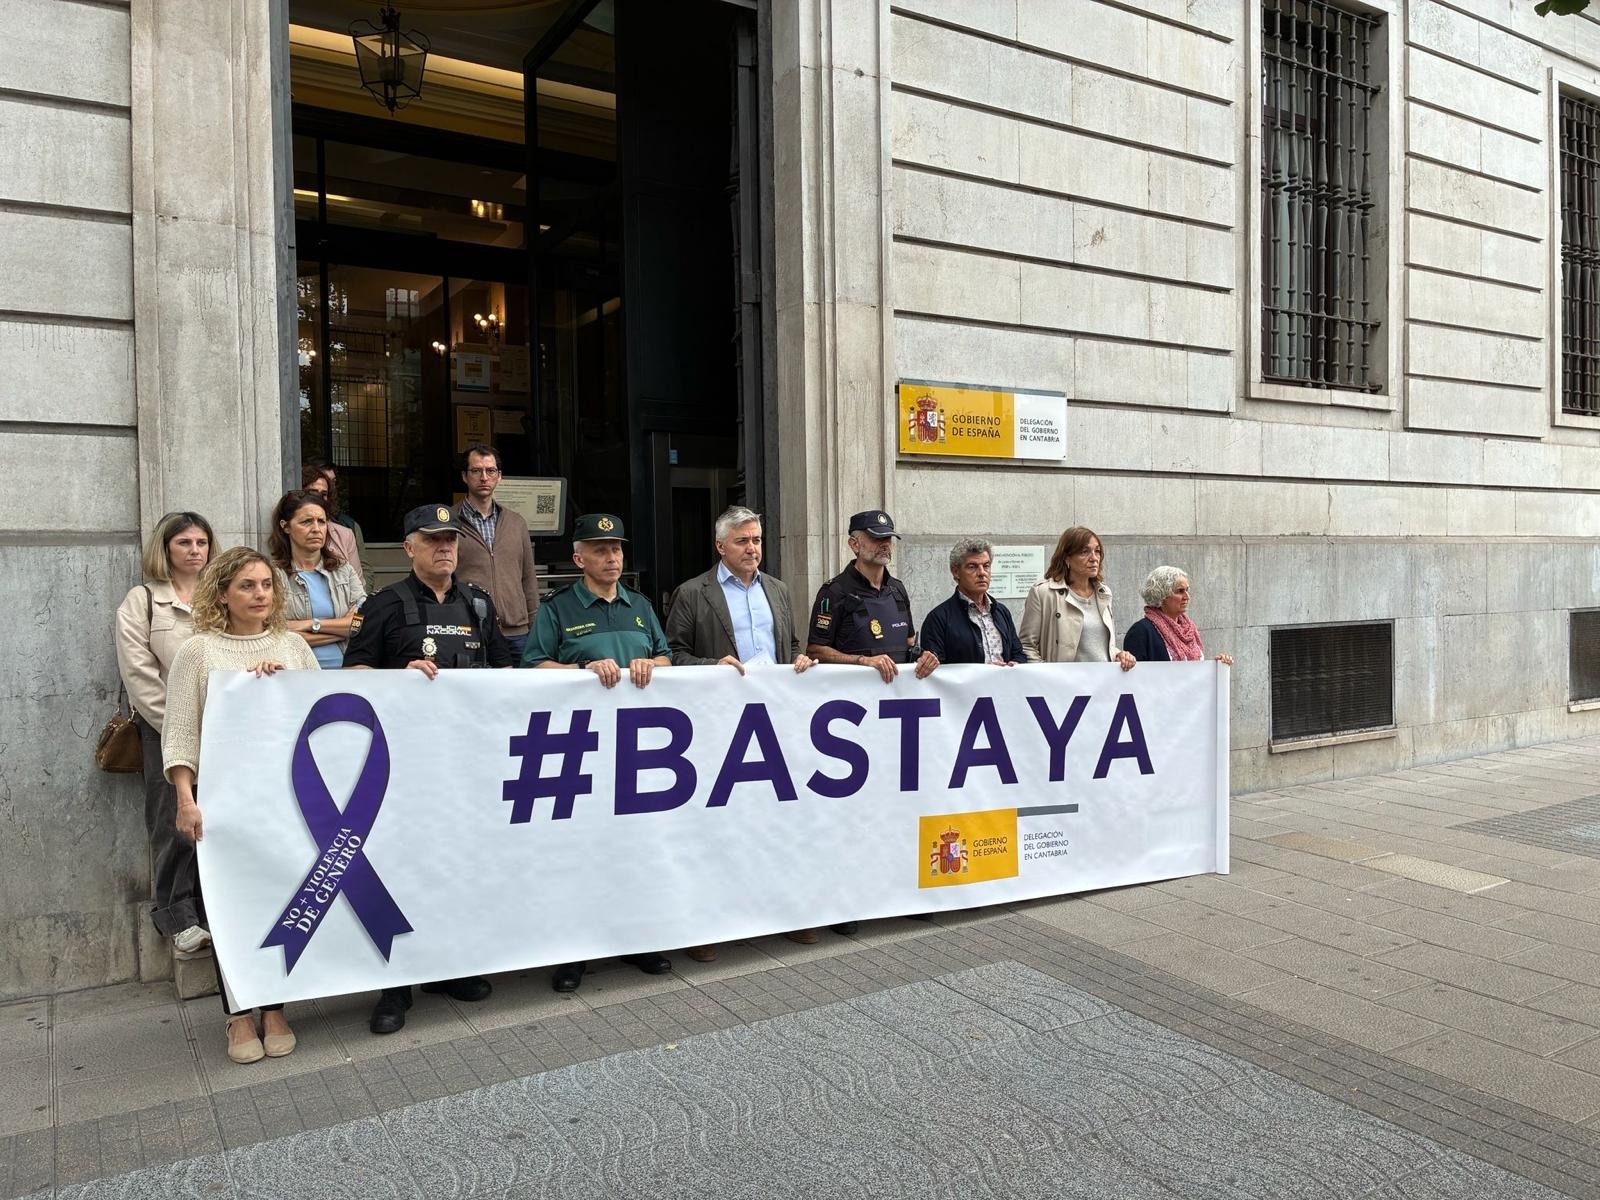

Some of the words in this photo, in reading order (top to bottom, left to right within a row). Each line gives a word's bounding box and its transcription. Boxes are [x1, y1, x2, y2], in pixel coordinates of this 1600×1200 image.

[952, 414, 1001, 426] GOBIERNO
[1020, 417, 1053, 426] DELEGACIÓN
[952, 427, 964, 437] DE
[967, 427, 1001, 438] ESPAÑA
[1032, 427, 1059, 435] GOBIERNO
[1029, 435, 1060, 443] CANTABRIA
[502, 693, 1155, 825] #BASTAYA
[973, 836, 1008, 848] GOBIERNO
[1024, 831, 1063, 841] DELEGACIÓN
[973, 849, 983, 857] DE
[984, 845, 1008, 856] ESPAÑA
[1024, 841, 1035, 851] DEL
[1037, 839, 1069, 849] GOBIERNO
[1024, 852, 1033, 860] EN
[1034, 849, 1068, 859] CANTABRIA
[282, 907, 301, 930] NO
[303, 827, 352, 893] VIOLENCIA
[295, 905, 320, 934] DE
[315, 835, 361, 903] GENERO
